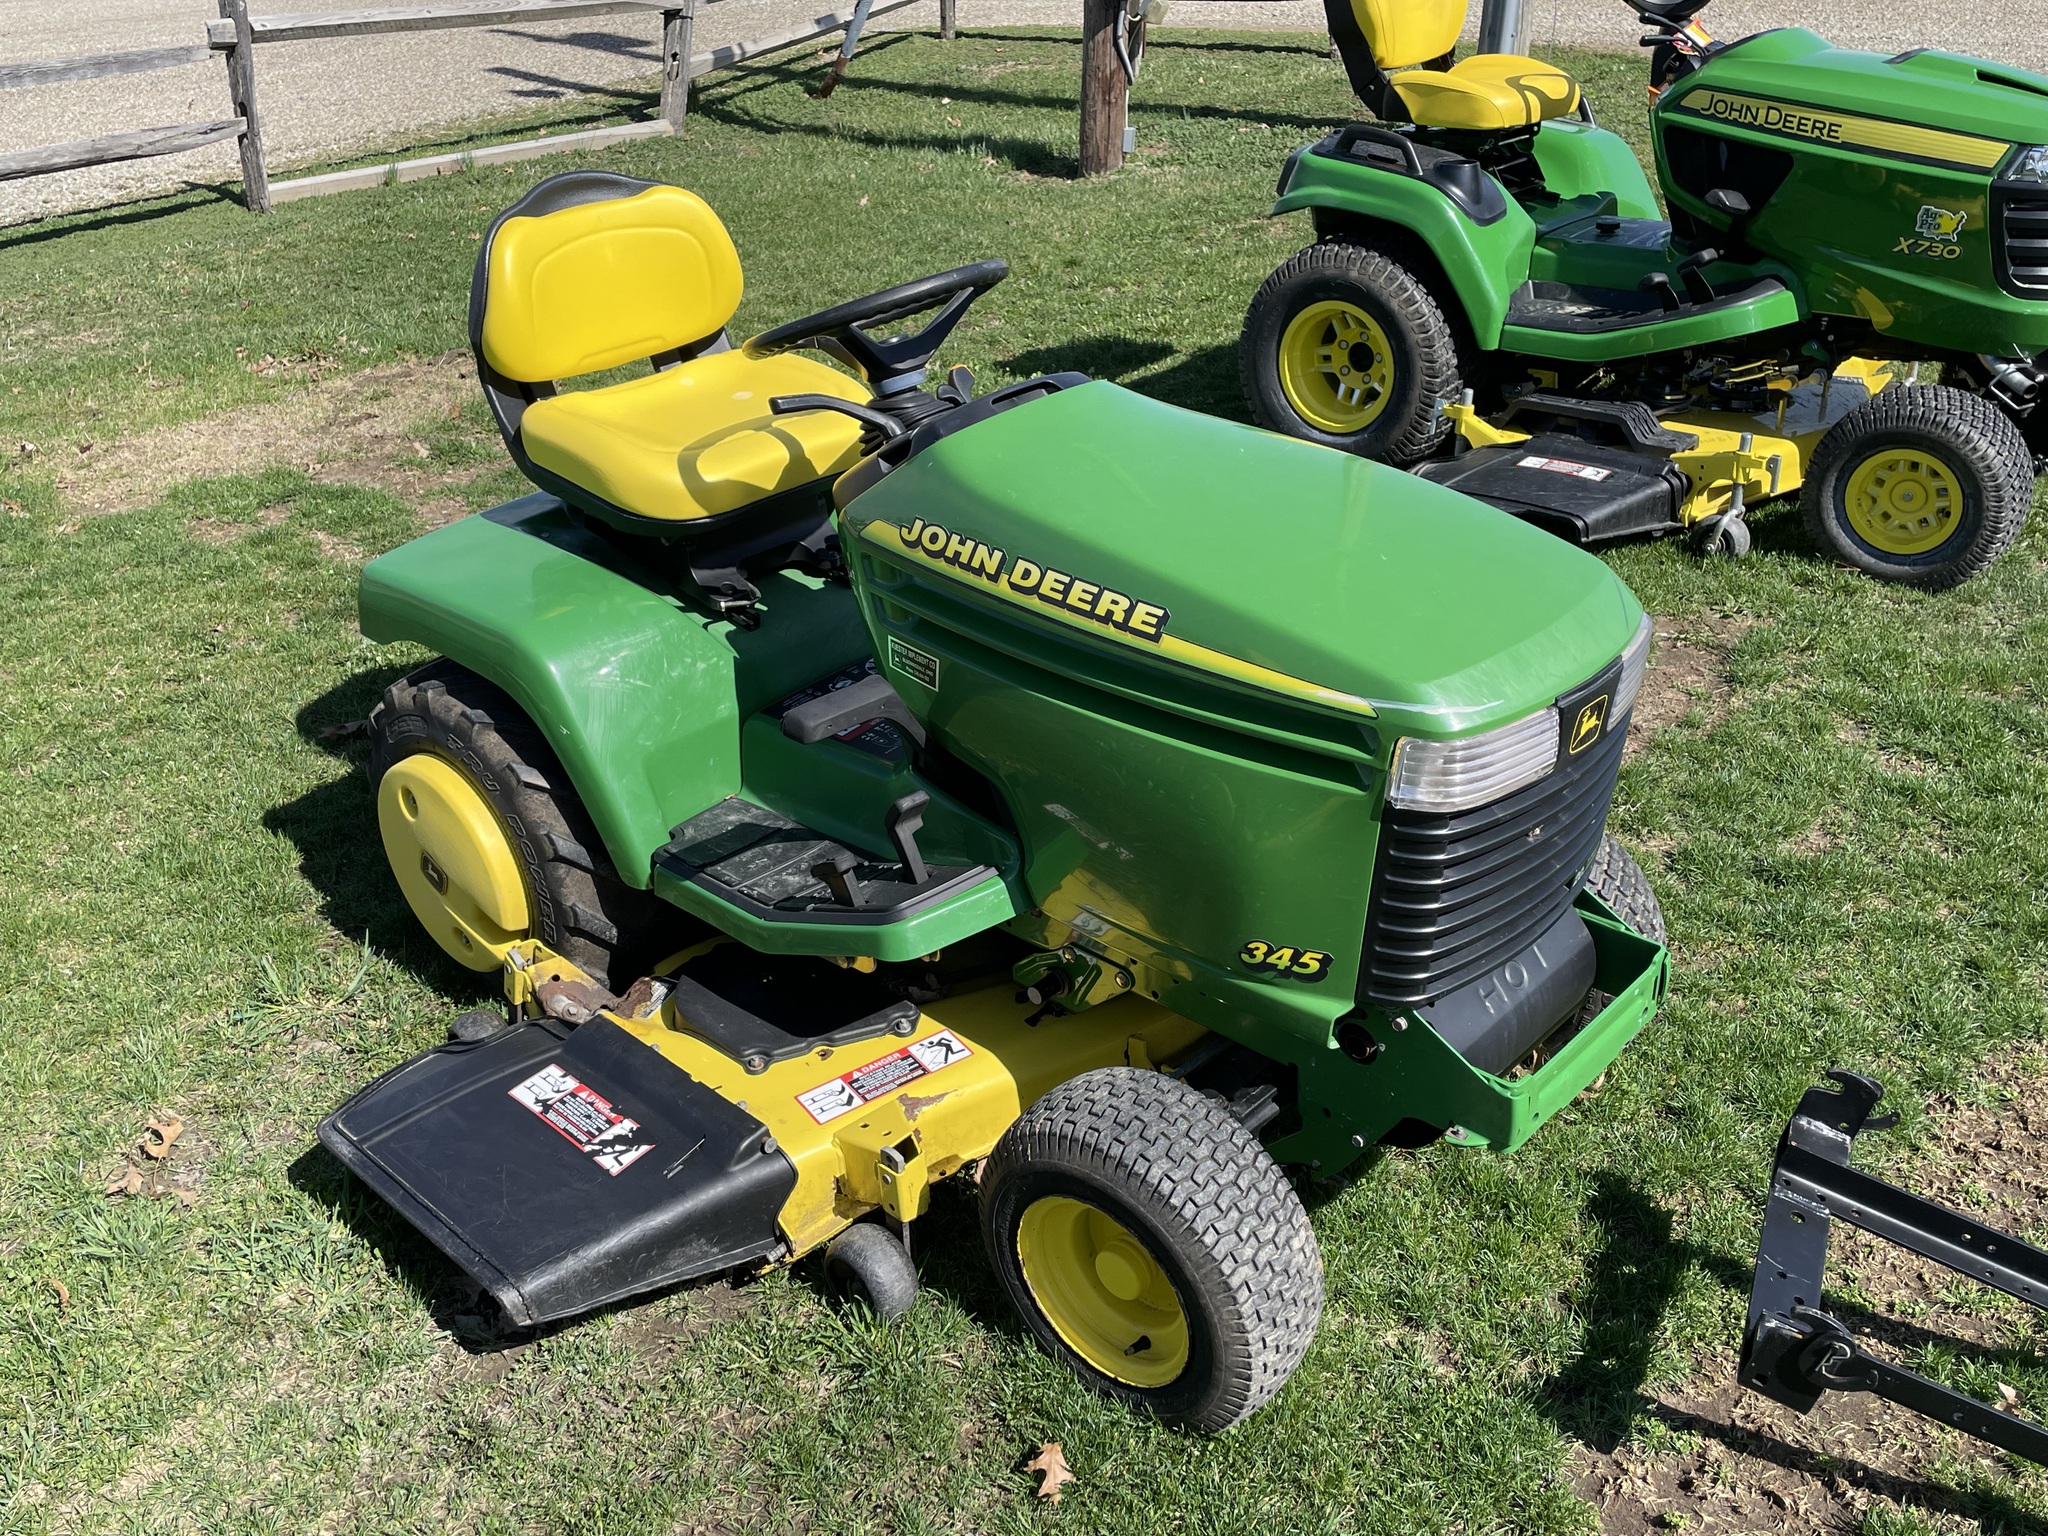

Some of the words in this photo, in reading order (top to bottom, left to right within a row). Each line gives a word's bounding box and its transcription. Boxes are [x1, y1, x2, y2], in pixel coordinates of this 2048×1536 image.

[1700, 94, 1760, 125] JOHN
[1764, 105, 1843, 140] DEERE
[1919, 219, 1942, 231] Pro
[1892, 236, 1961, 259] X730
[900, 516, 1006, 581] JOHN
[1007, 557, 1169, 640] DEERE
[505, 813, 557, 944] POWER
[1240, 940, 1330, 980] 345
[860, 1052, 902, 1074] DANGER
